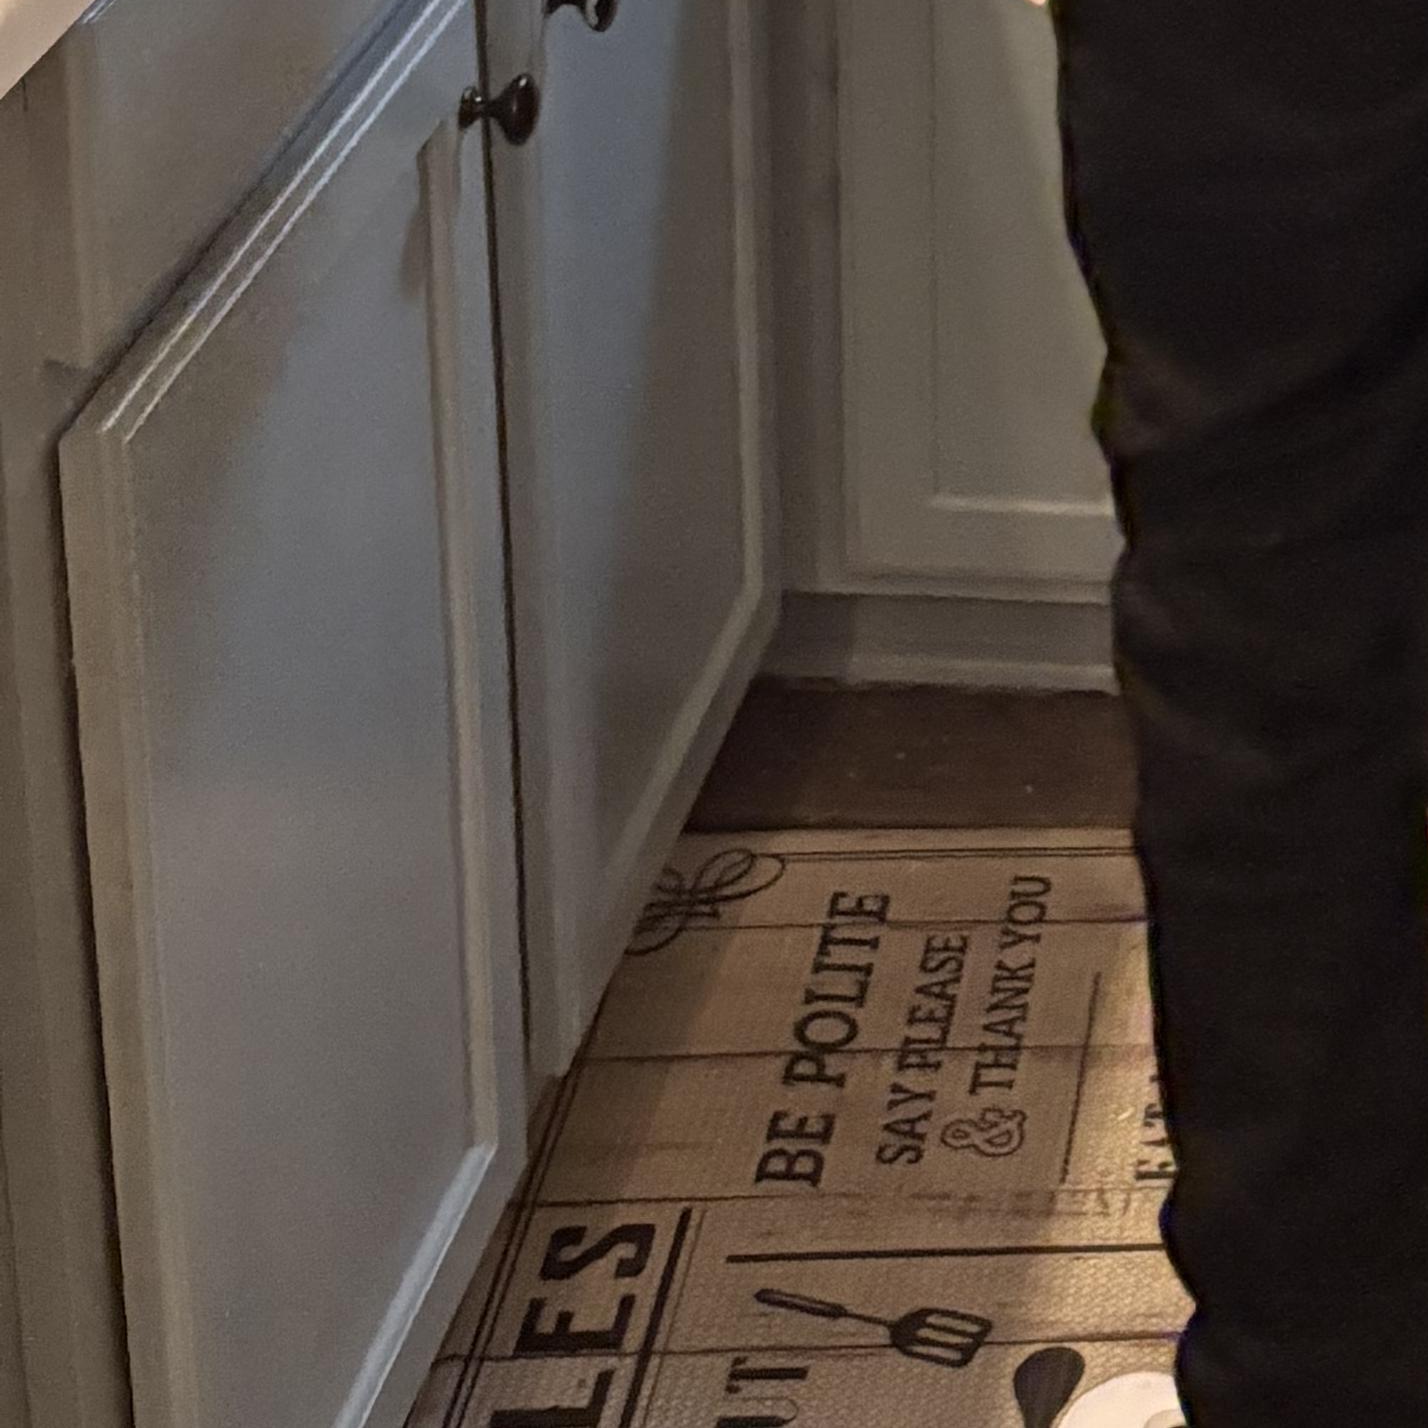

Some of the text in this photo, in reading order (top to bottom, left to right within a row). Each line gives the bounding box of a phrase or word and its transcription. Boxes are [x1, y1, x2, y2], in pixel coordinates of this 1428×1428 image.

[997, 874, 1053, 953] YOU
[754, 891, 891, 1188] BE POLITE
[875, 933, 971, 1165] SAY PLEASE
[967, 955, 1037, 1095] THANK
